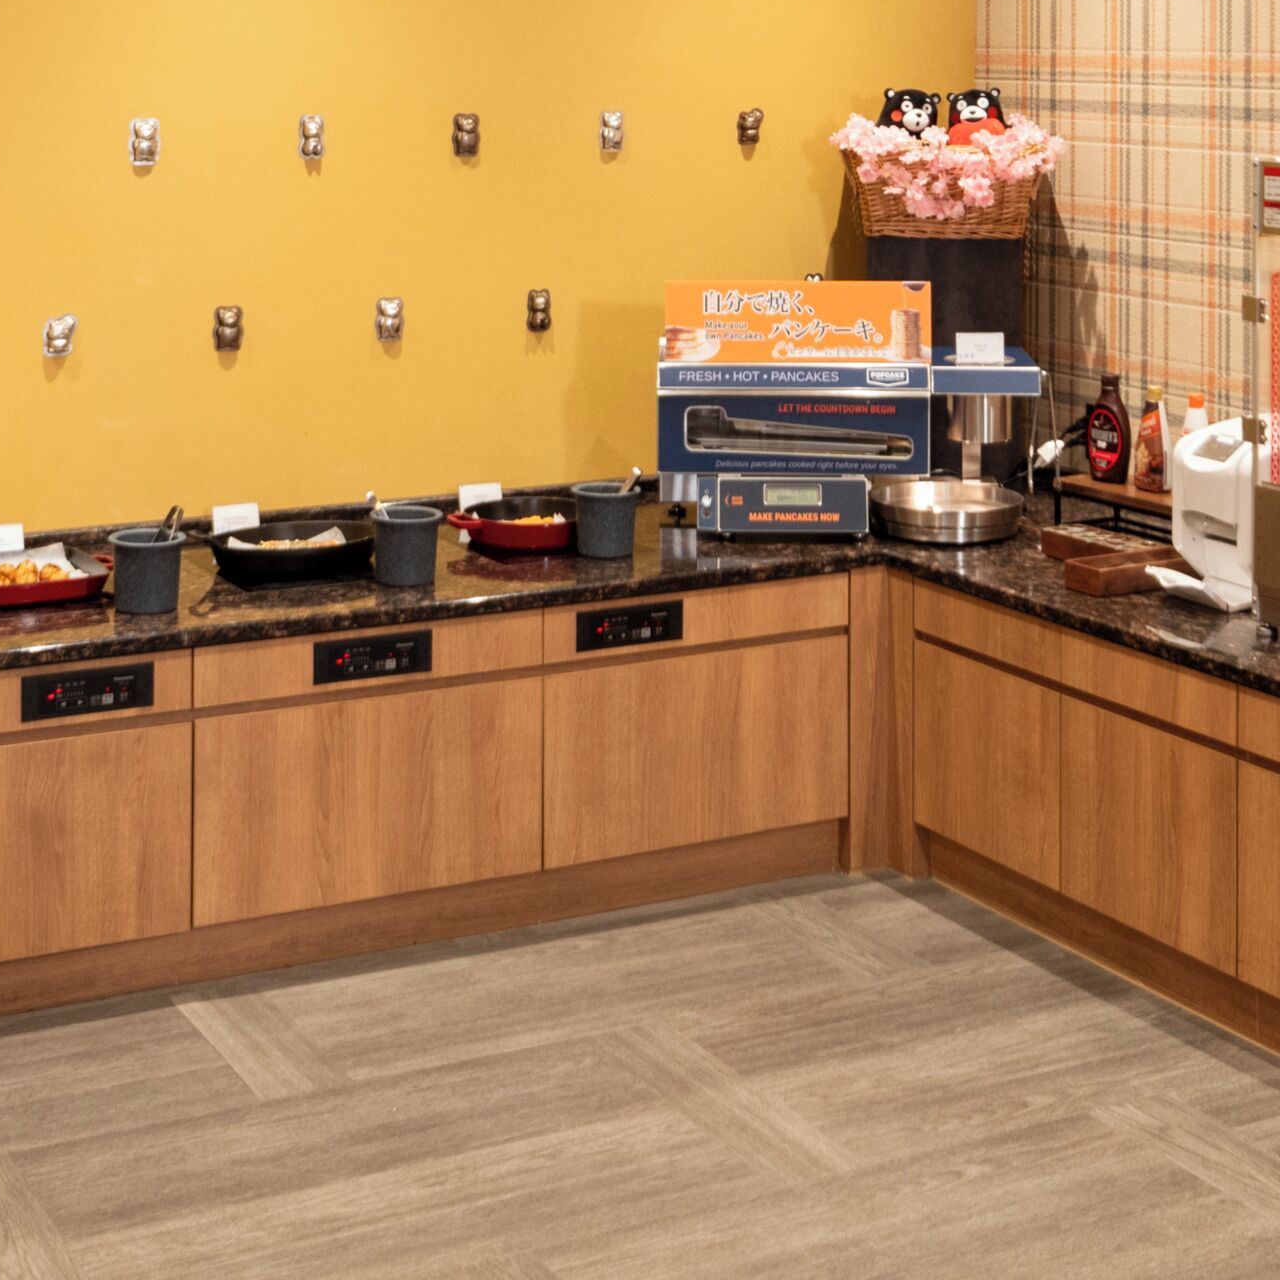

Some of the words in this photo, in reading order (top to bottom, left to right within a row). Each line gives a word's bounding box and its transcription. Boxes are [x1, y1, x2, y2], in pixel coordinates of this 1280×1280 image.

[703, 290, 814, 315] 自分で焼く、
[705, 321, 726, 329] Make
[729, 322, 747, 331] your
[769, 320, 883, 343] パンケーキ。
[705, 332, 722, 340] own
[679, 370, 721, 382] FRESH
[733, 370, 760, 382] HOT
[771, 371, 839, 383] PANCAKES
[778, 403, 795, 413] LET
[796, 403, 813, 413] THE
[814, 403, 869, 414] COUNTDOWN
[870, 405, 897, 414] BEGIN
[716, 459, 749, 468] Delicious
[750, 459, 787, 470] pancakes
[749, 512, 773, 522] MAKE
[774, 512, 819, 522] PANCAKES
[820, 512, 840, 522] NOW
